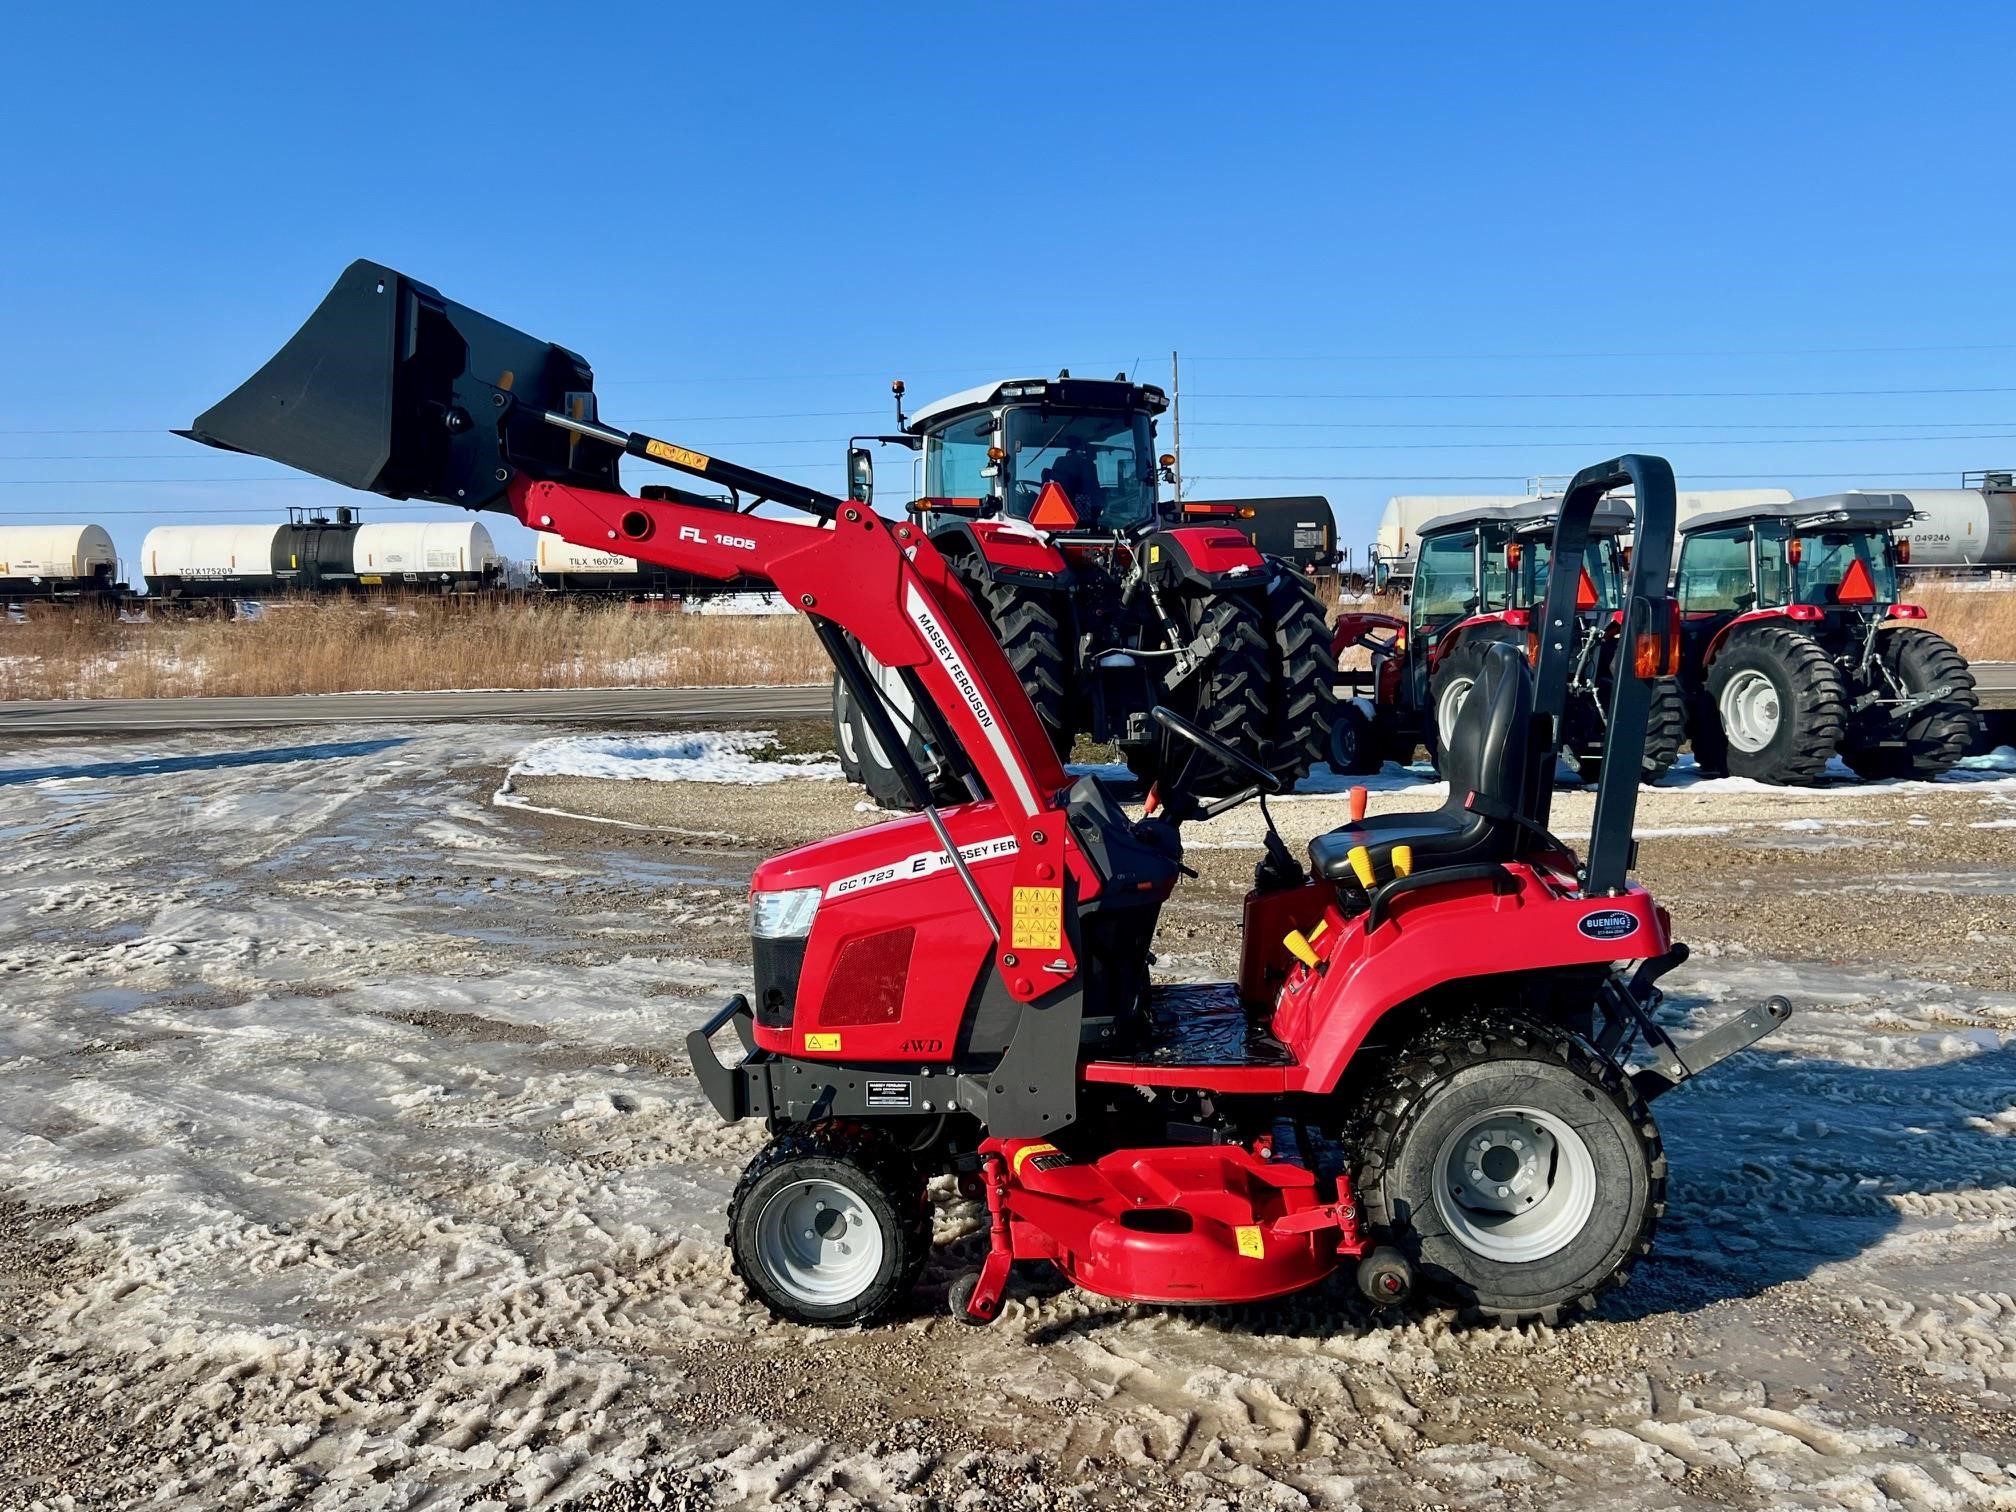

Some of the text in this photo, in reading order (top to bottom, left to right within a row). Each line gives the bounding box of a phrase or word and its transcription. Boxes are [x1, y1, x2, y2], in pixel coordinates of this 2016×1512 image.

[679, 526, 756, 550] FL 1805
[1914, 534, 1950, 542] 049246
[918, 613, 993, 728] MASSEY FERGUSON
[939, 846, 989, 866] MSSEY
[912, 858, 927, 872] E
[839, 869, 894, 892] GC 1723
[1586, 917, 1626, 928] BUENING
[899, 1039, 943, 1053] 4WD
